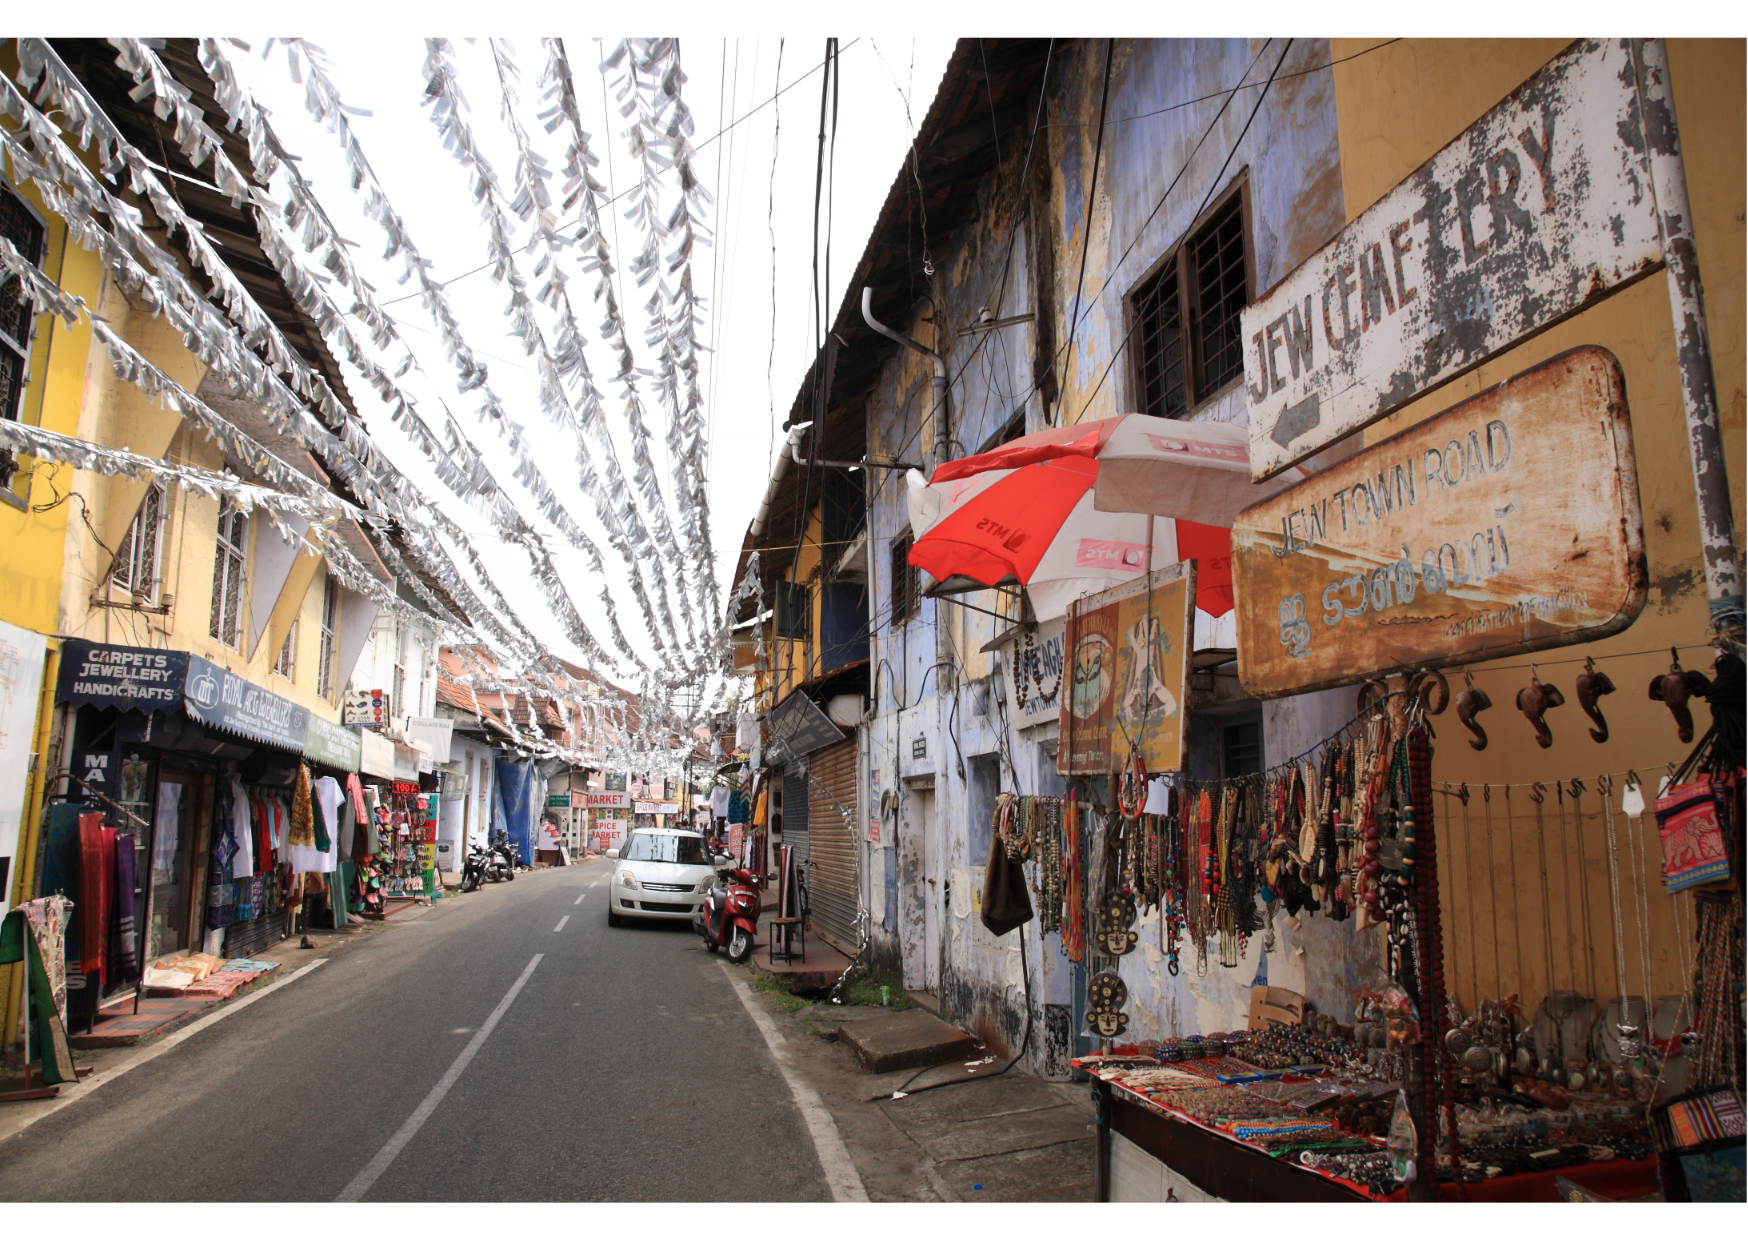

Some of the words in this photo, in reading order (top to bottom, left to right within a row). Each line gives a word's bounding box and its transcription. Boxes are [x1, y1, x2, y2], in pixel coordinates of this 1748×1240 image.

[1251, 291, 1314, 405] JEW
[1322, 109, 1557, 352] CEMETERY
[1270, 498, 1328, 559] JEW
[1333, 459, 1416, 532] TOWN
[1424, 420, 1512, 498] ROAD
[88, 649, 168, 668] CARPETS
[79, 663, 174, 682] JEWELLERY
[73, 681, 175, 700] HANDICRAFTS
[412, 720, 452, 729] COLLATERAL
[595, 822, 617, 830] SPICE
